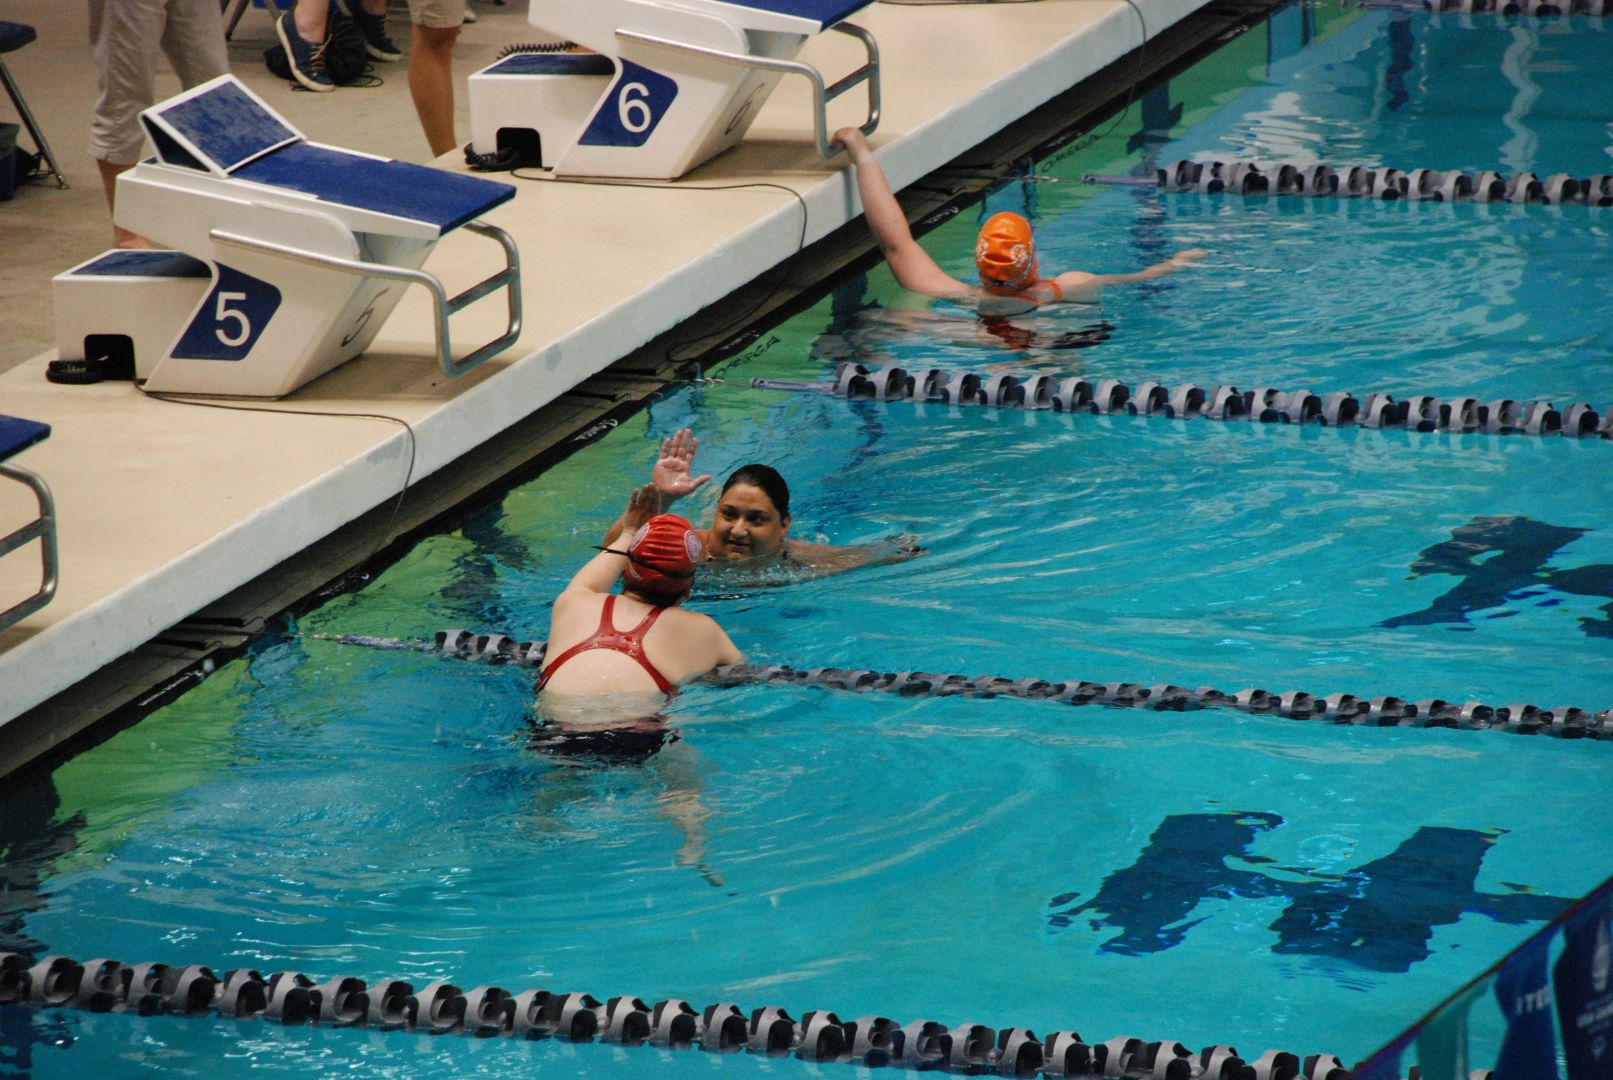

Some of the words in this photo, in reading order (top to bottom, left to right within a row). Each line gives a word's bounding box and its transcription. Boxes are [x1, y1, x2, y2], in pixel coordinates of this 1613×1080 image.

[618, 82, 651, 133] 6
[215, 292, 250, 347] 5
[340, 286, 391, 347] 5
